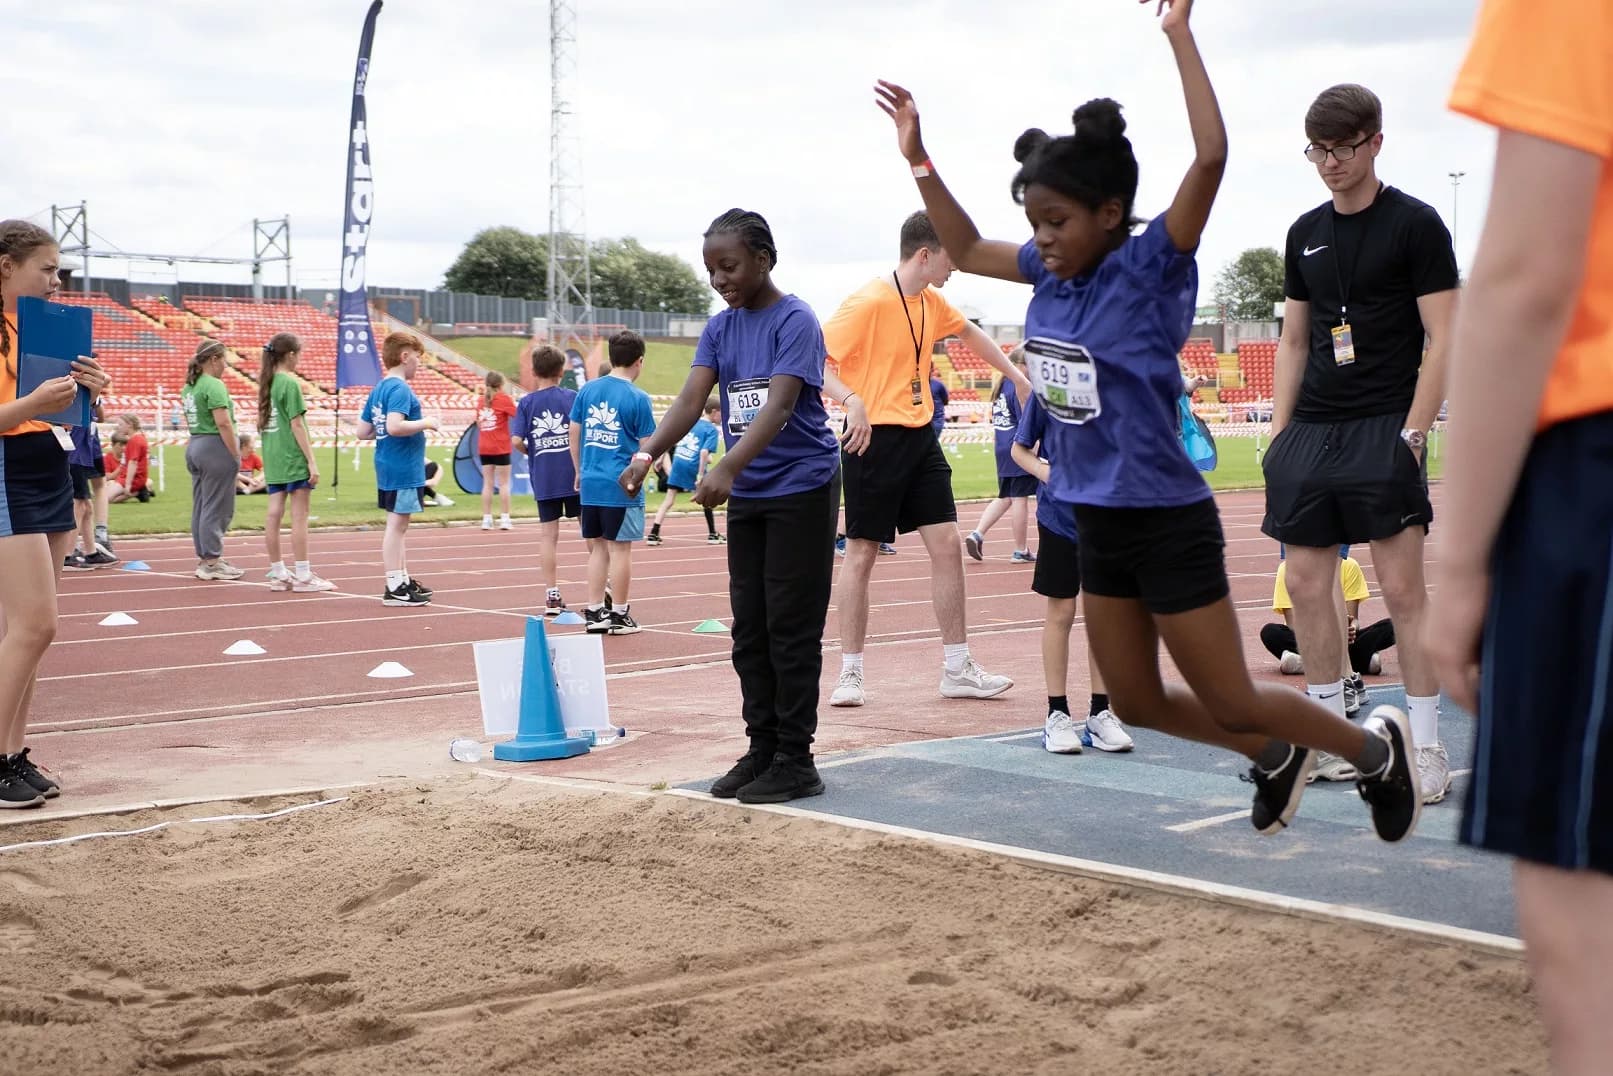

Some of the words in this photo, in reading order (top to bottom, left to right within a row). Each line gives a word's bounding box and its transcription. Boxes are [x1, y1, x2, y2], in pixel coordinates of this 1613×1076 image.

[1041, 361, 1068, 385] 619
[738, 393, 761, 409] 618
[542, 437, 569, 449] SPORT
[592, 432, 619, 444] SPORT
